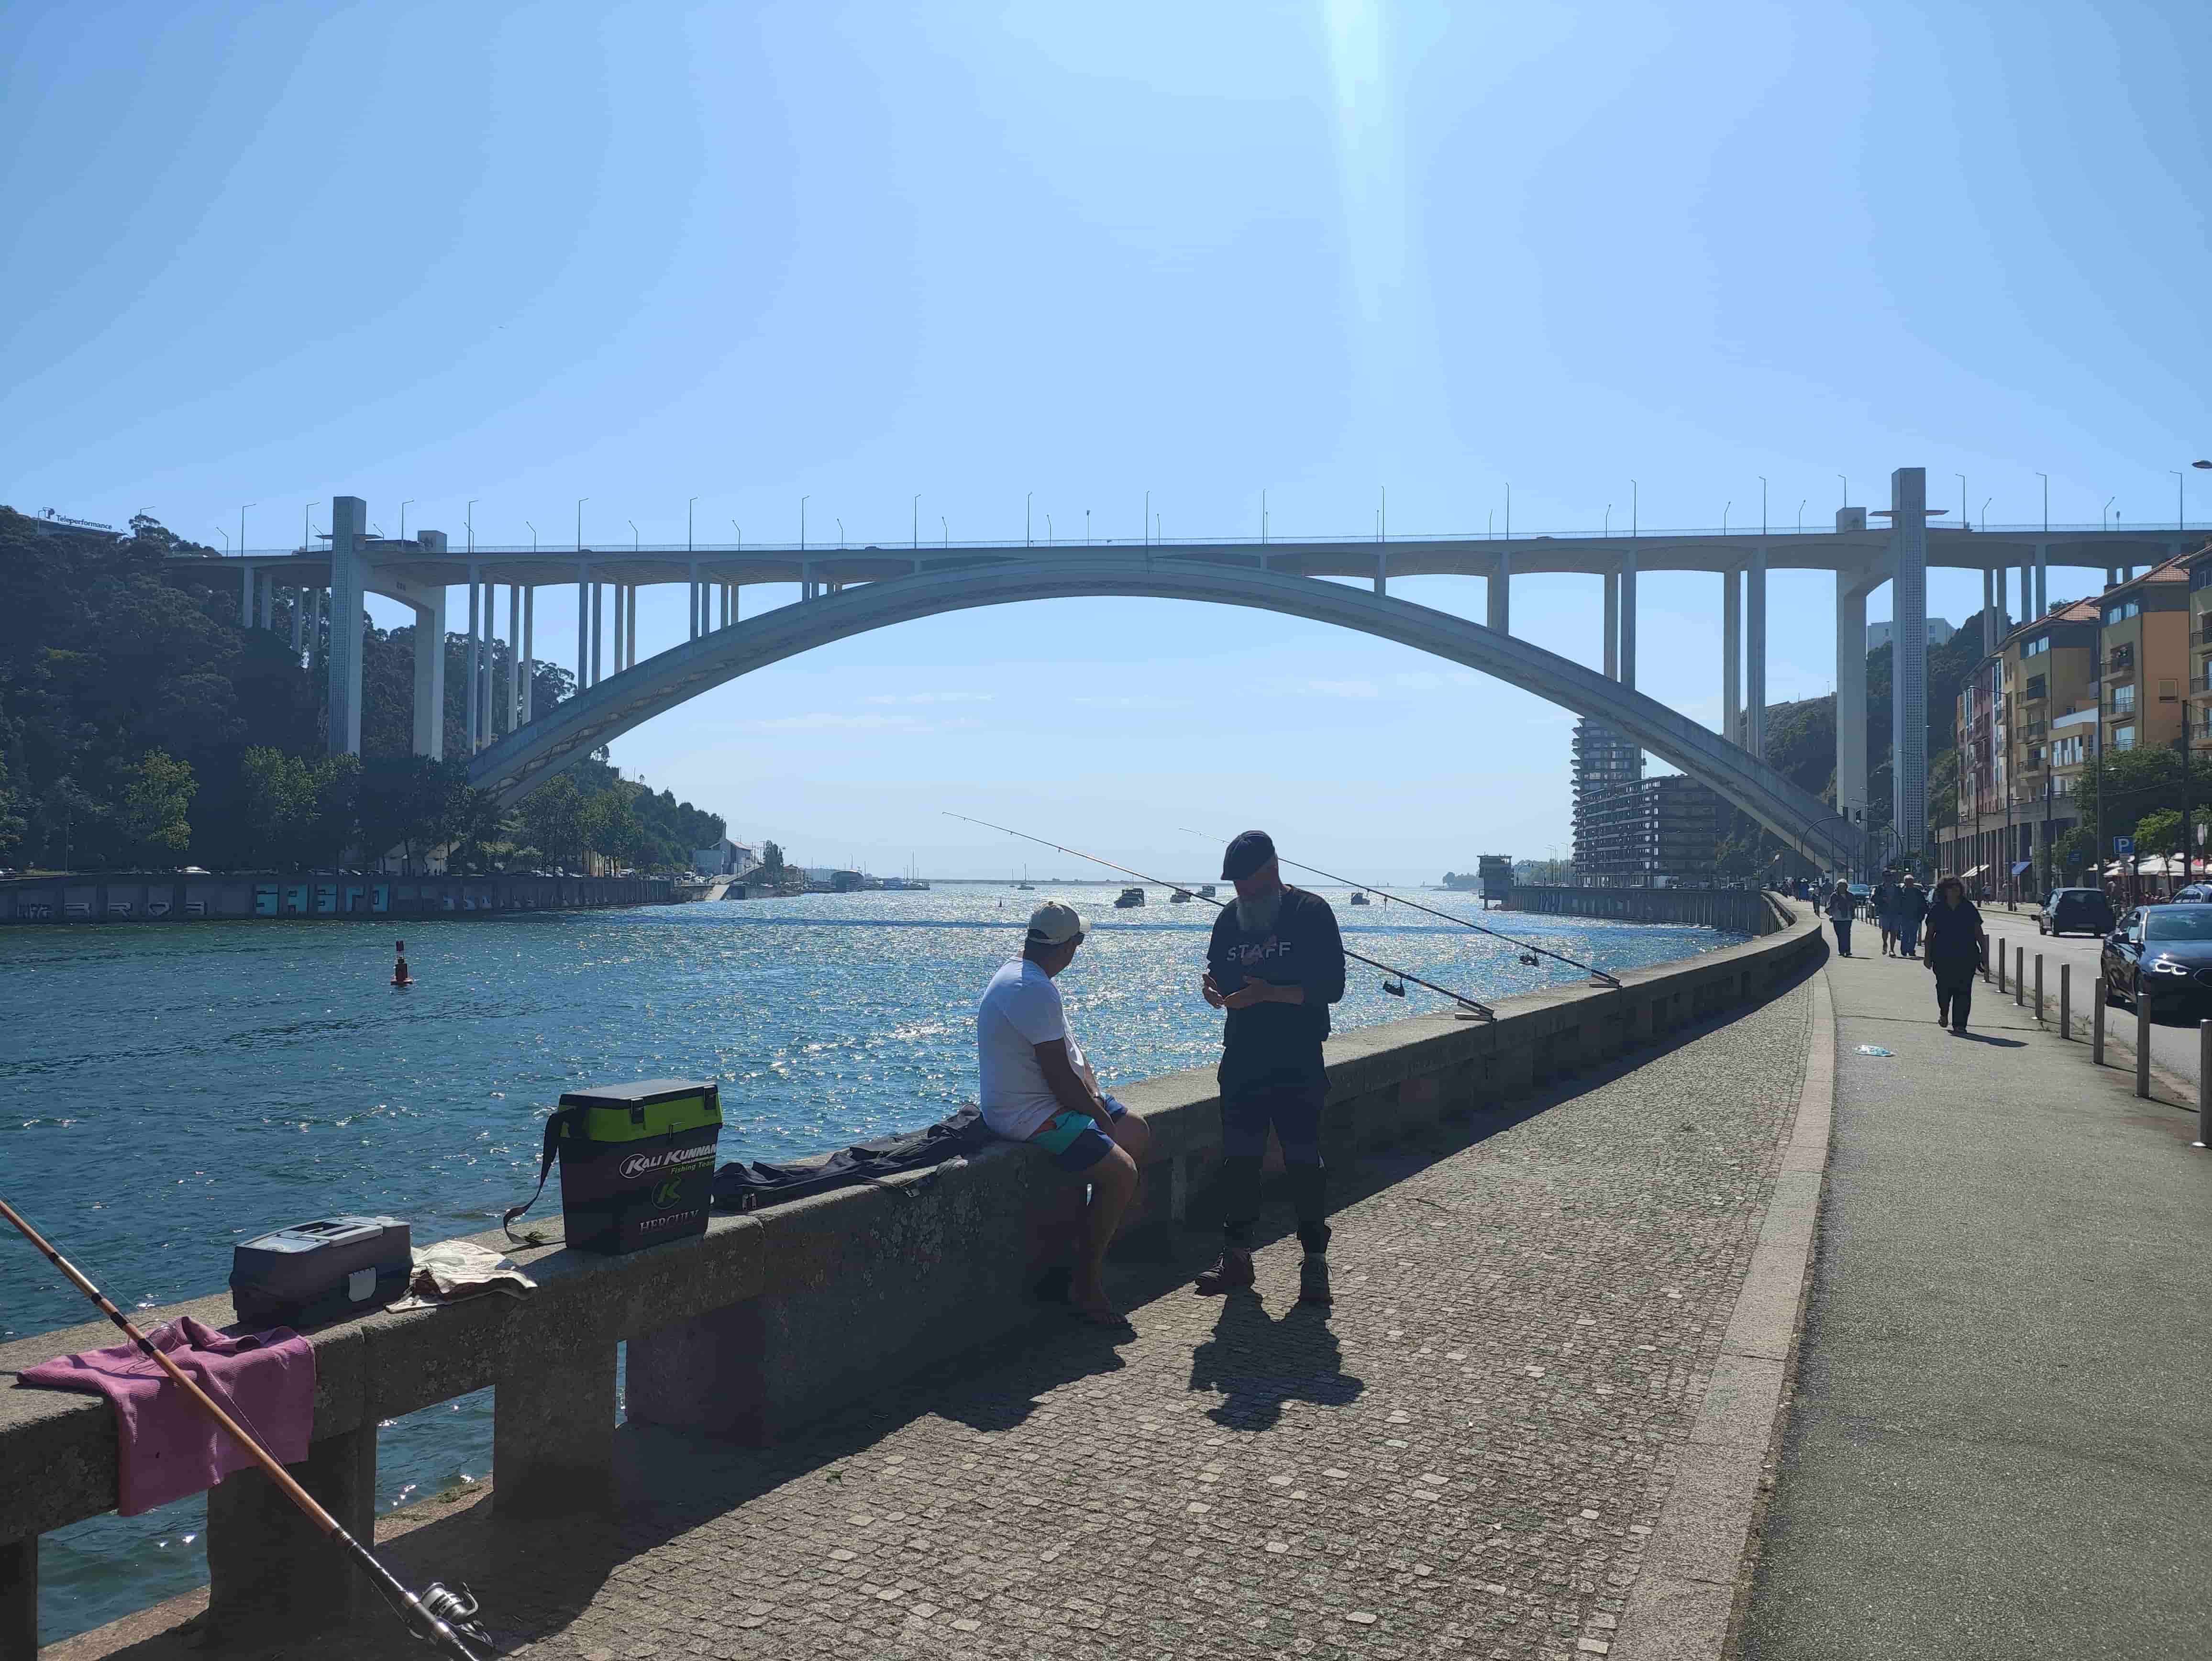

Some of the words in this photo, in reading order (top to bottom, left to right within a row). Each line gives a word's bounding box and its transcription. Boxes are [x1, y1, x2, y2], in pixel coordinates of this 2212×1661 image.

[56, 514, 112, 529] Teleperformance
[2119, 839, 2129, 852] P
[1227, 941, 1291, 962] STAFF
[623, 1154, 663, 1175] KALI
[671, 1163, 697, 1175] Fishing
